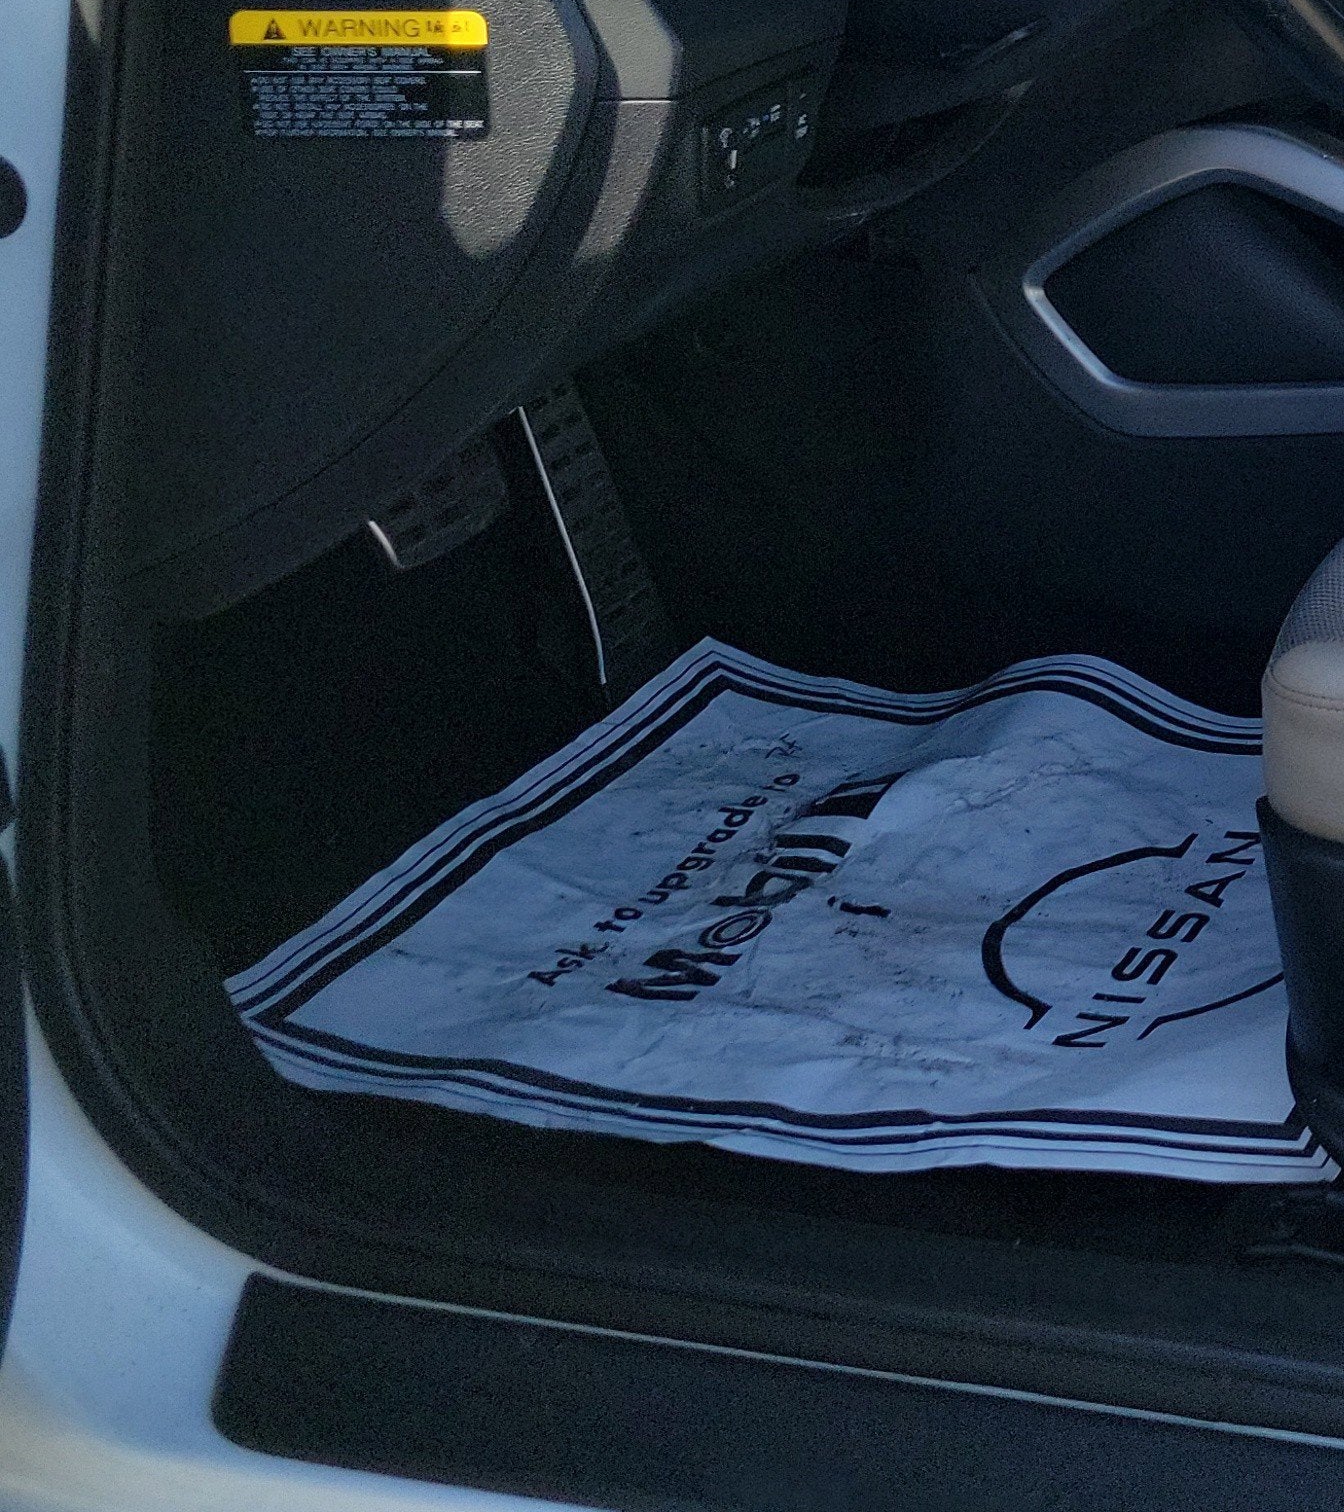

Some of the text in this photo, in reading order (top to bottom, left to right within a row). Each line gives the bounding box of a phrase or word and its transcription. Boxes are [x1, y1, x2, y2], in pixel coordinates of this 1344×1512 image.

[293, 47, 316, 57] SEE
[297, 18, 420, 38] WARNING
[527, 941, 610, 987] Ask
[593, 906, 643, 933] to
[638, 795, 768, 905] upgrade
[604, 833, 852, 1001] Mobil
[1051, 831, 1262, 1048] NISSAN
